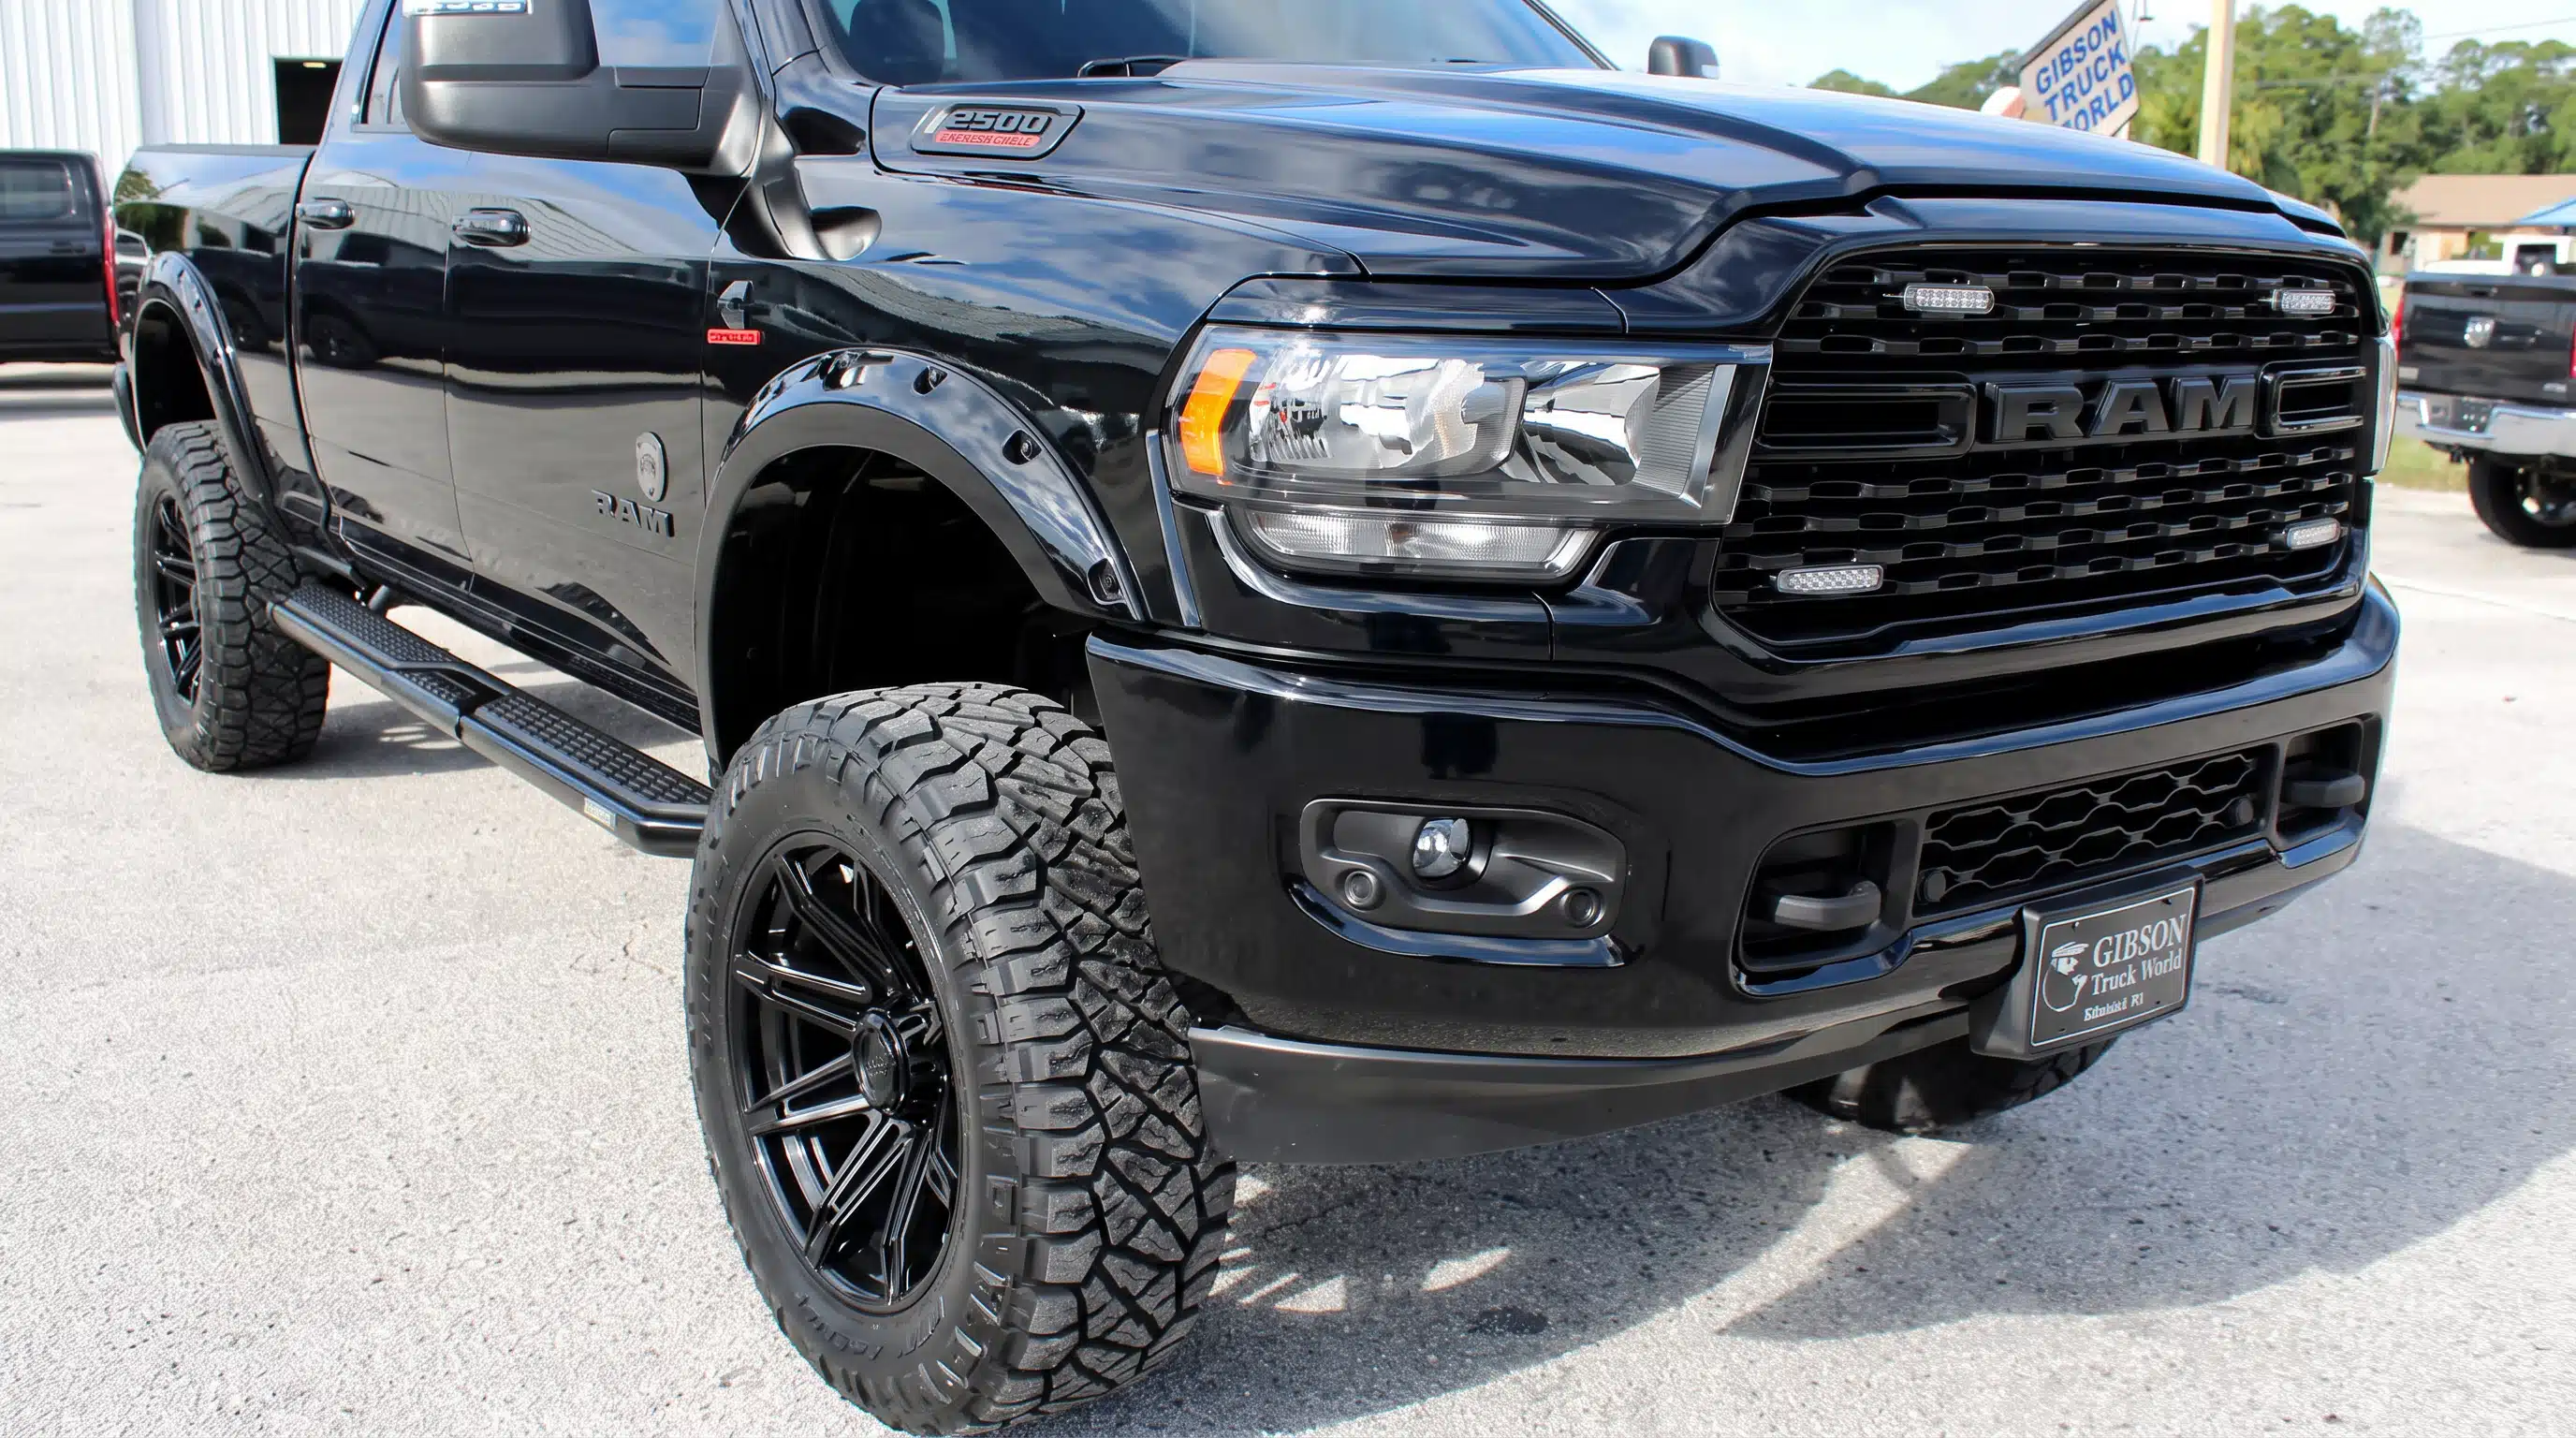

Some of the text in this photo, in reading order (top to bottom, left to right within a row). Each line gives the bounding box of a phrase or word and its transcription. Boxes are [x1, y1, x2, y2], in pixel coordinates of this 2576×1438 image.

[2036, 10, 2117, 95] GIBSON
[2044, 39, 2126, 122] TRUCK
[944, 110, 1053, 135] 2500
[2061, 71, 2134, 132] ORLD
[1986, 375, 2255, 442] RAM
[591, 490, 675, 537] RAM
[2092, 913, 2188, 968] GIBSON
[2091, 947, 2183, 996] Truck World
